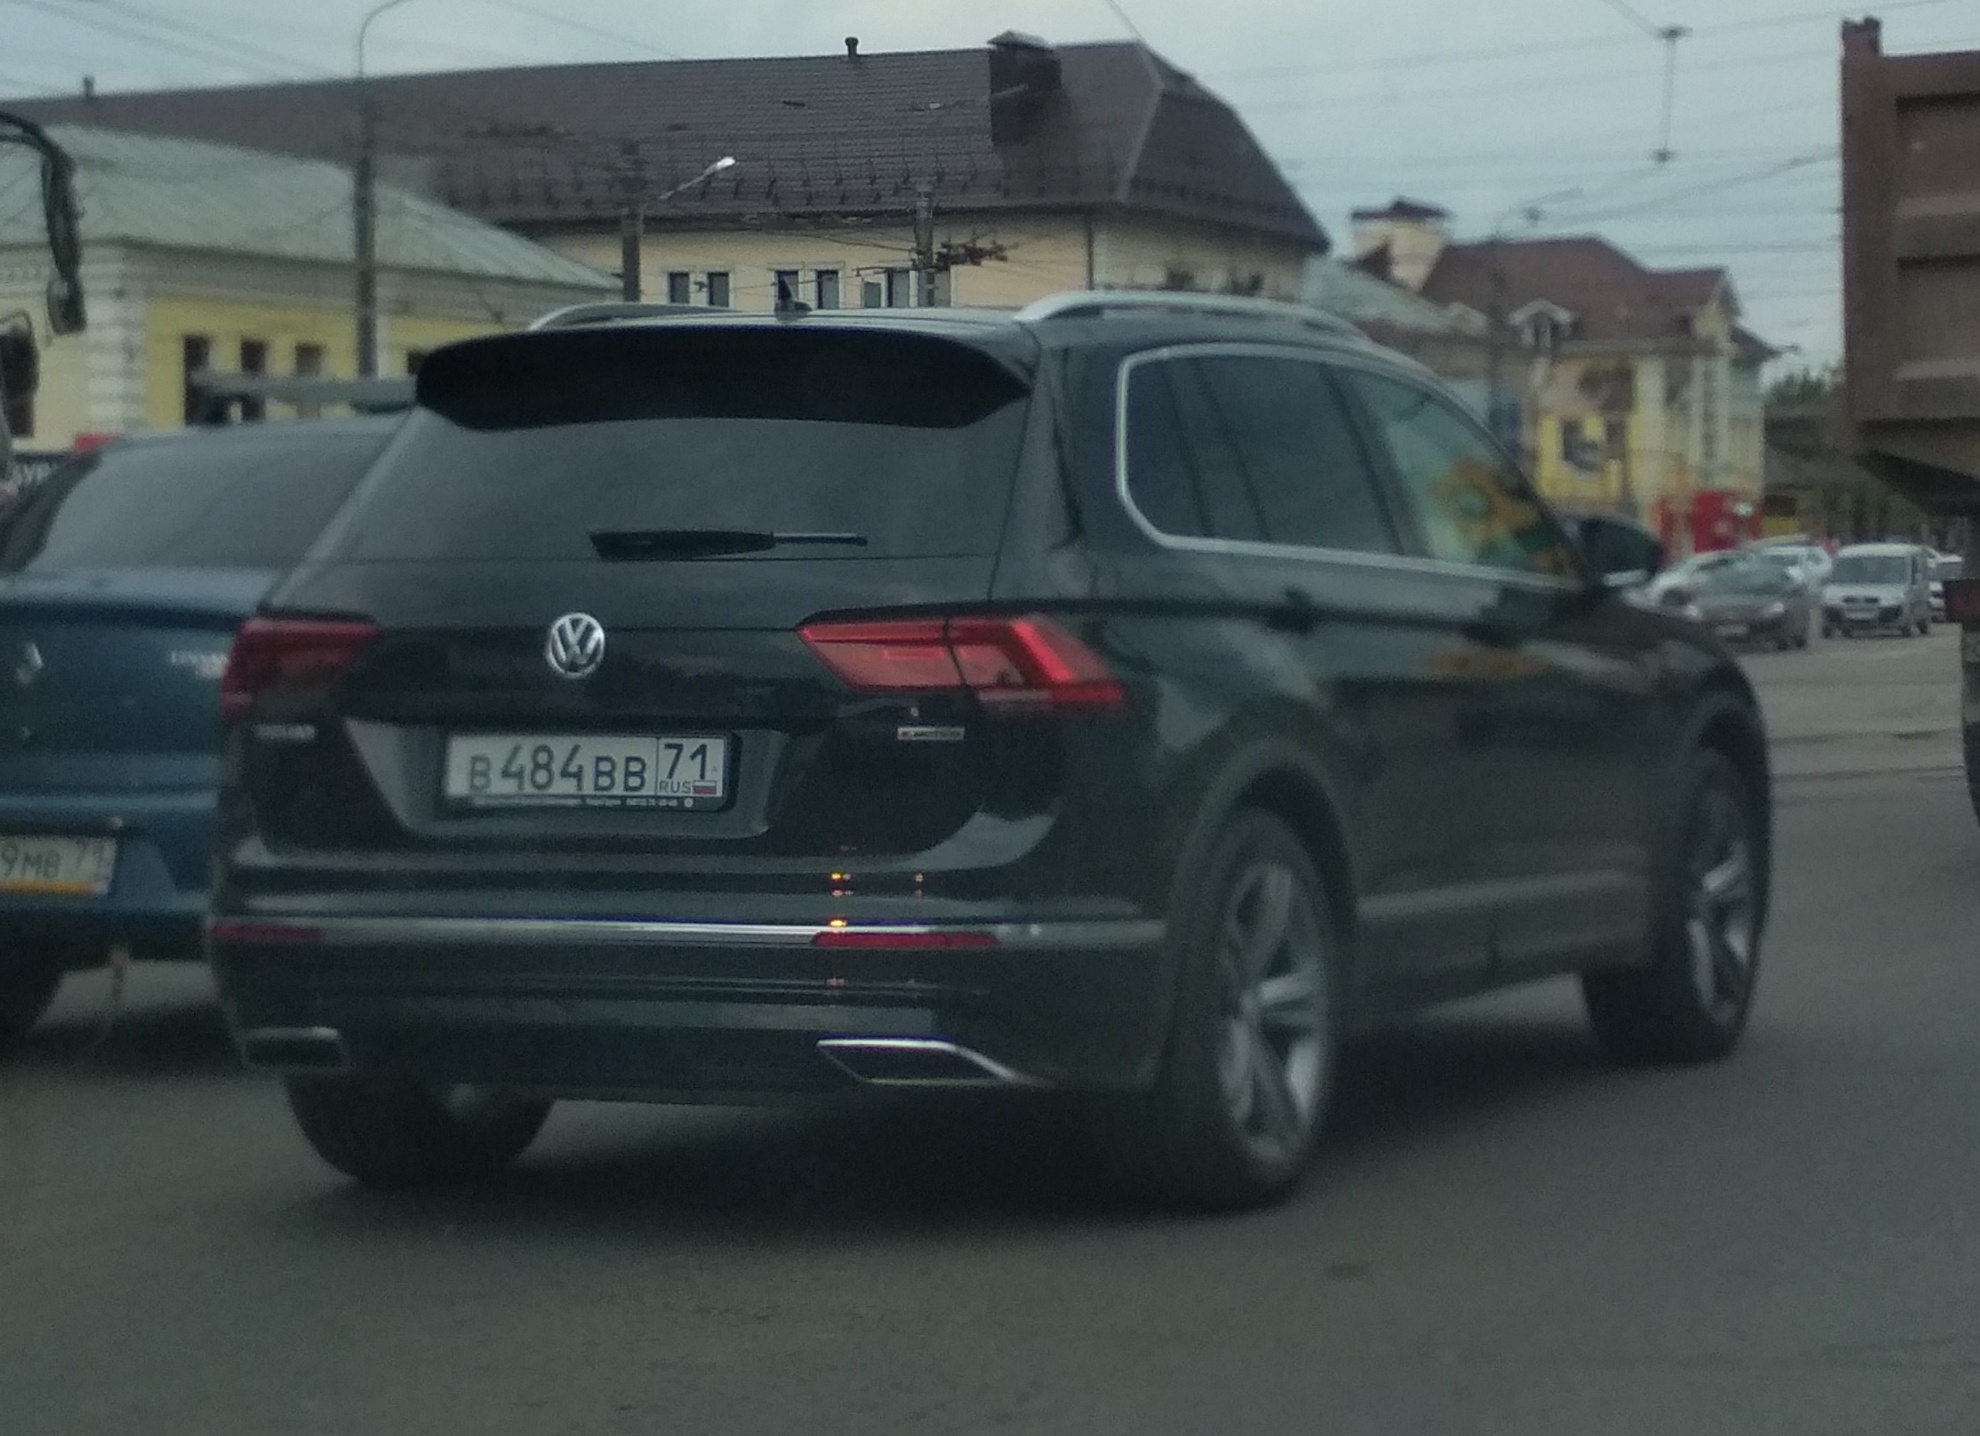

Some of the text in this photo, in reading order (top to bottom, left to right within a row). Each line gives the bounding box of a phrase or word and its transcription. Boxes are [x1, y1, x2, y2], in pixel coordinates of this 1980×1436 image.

[549, 612, 605, 674] VW
[663, 742, 710, 780] 71
[658, 780, 691, 794] RUS
